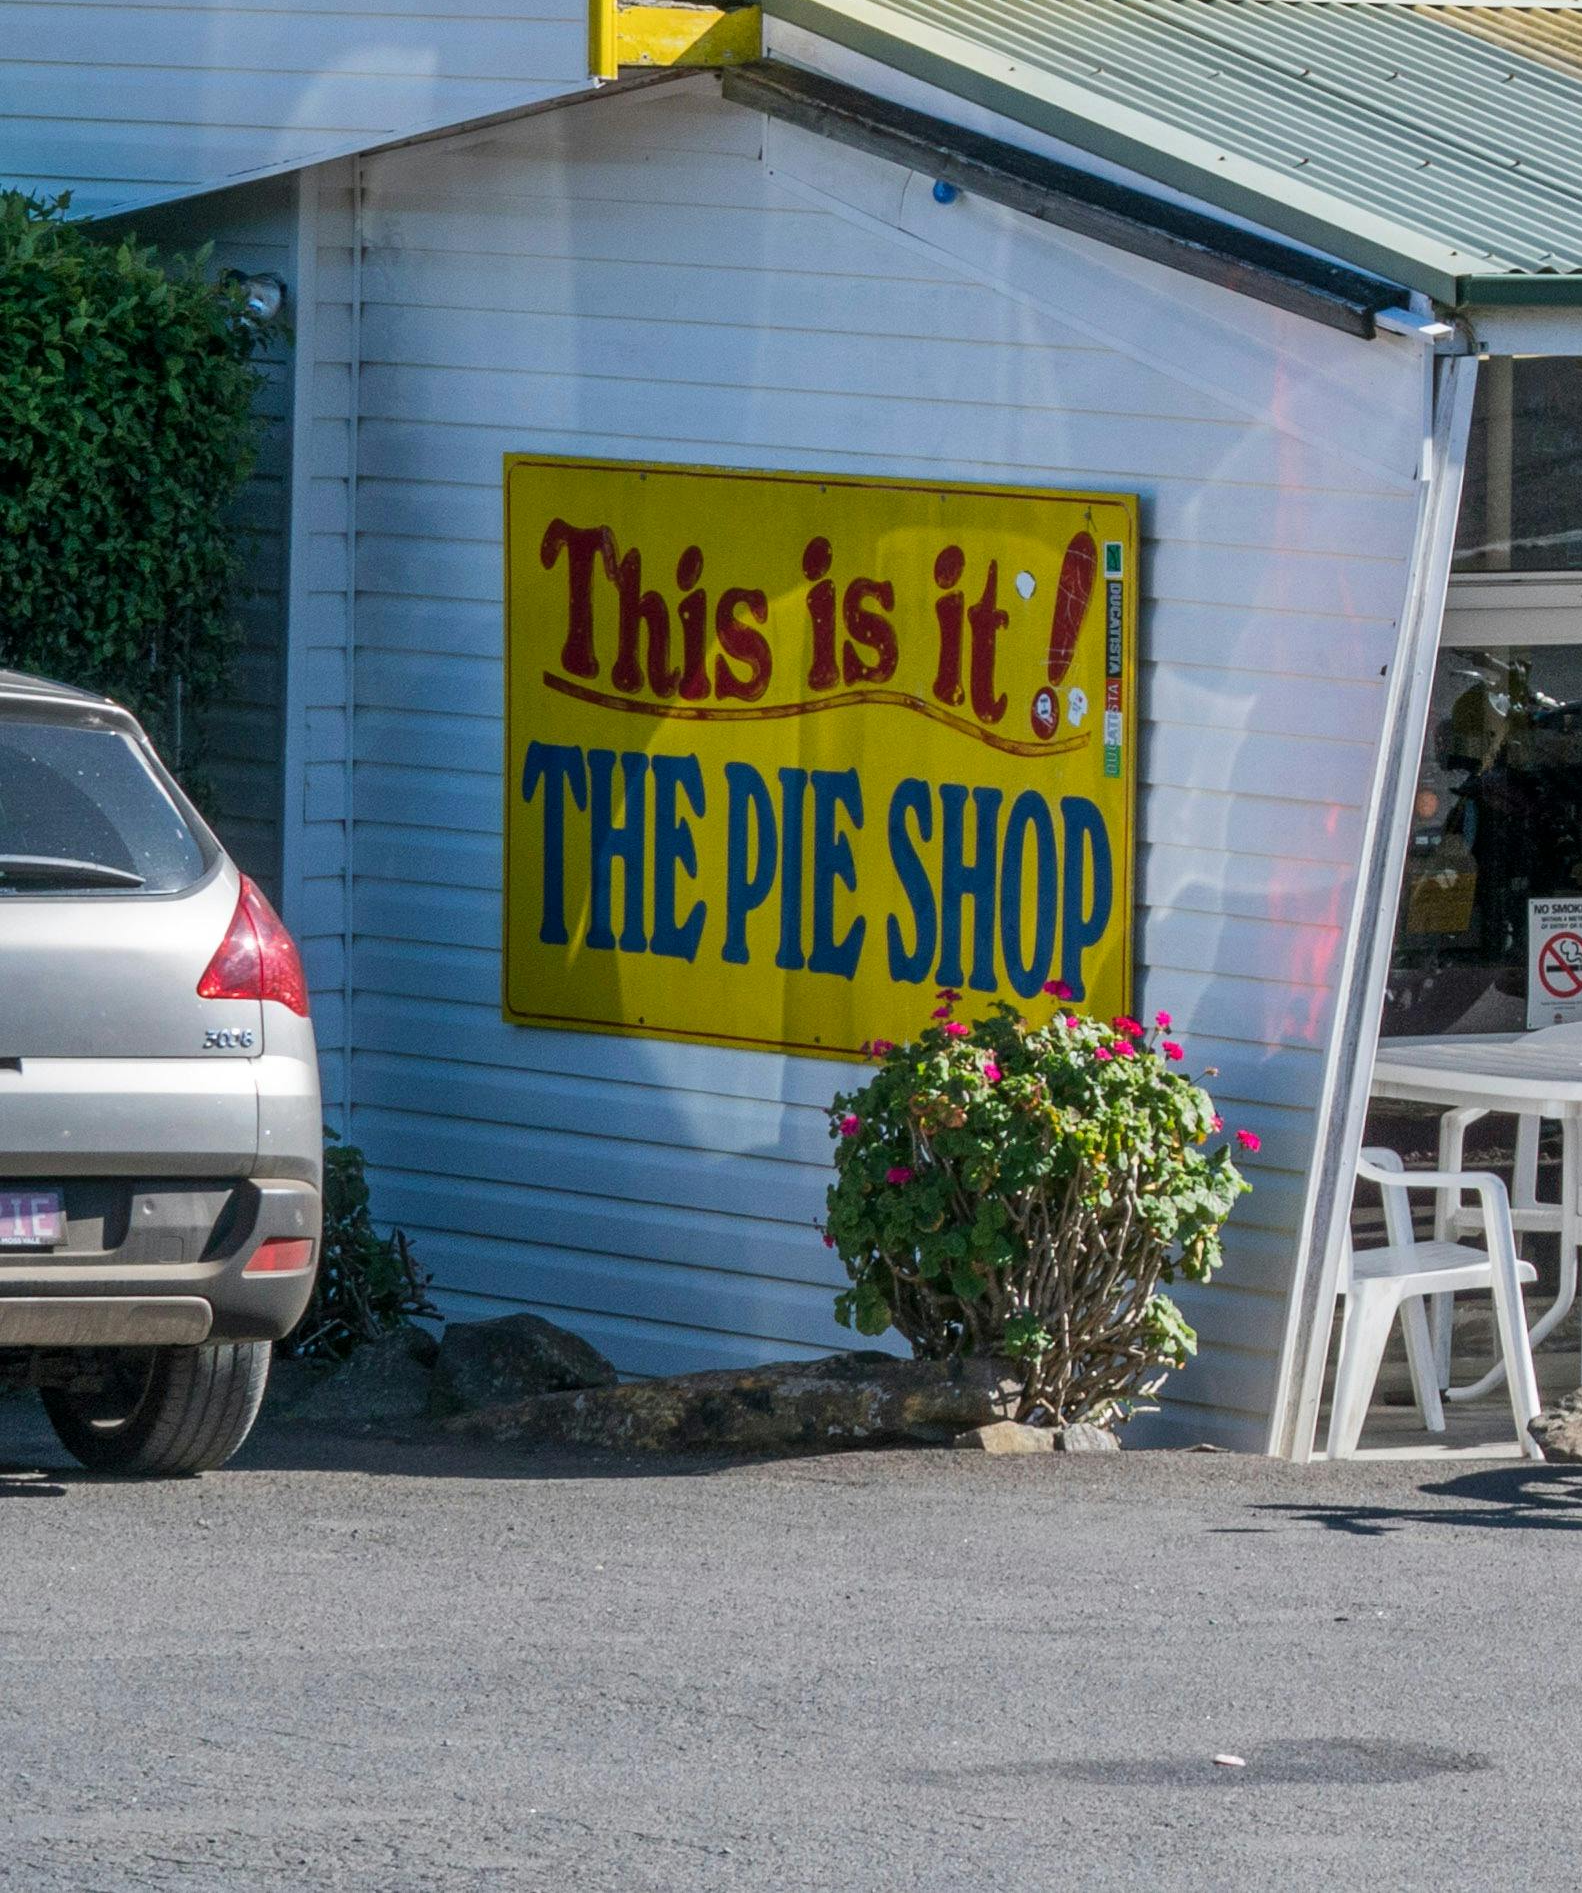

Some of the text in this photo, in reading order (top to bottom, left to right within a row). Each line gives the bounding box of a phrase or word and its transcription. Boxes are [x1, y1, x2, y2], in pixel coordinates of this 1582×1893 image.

[541, 518, 773, 701] This
[802, 536, 899, 690] is
[1107, 581, 1122, 675] DUCATISTA
[523, 740, 1113, 1003] THE PIE SHOP
[1534, 904, 1549, 915] NO
[202, 1028, 254, 1049] 3008
[0, 1198, 54, 1236] IE
